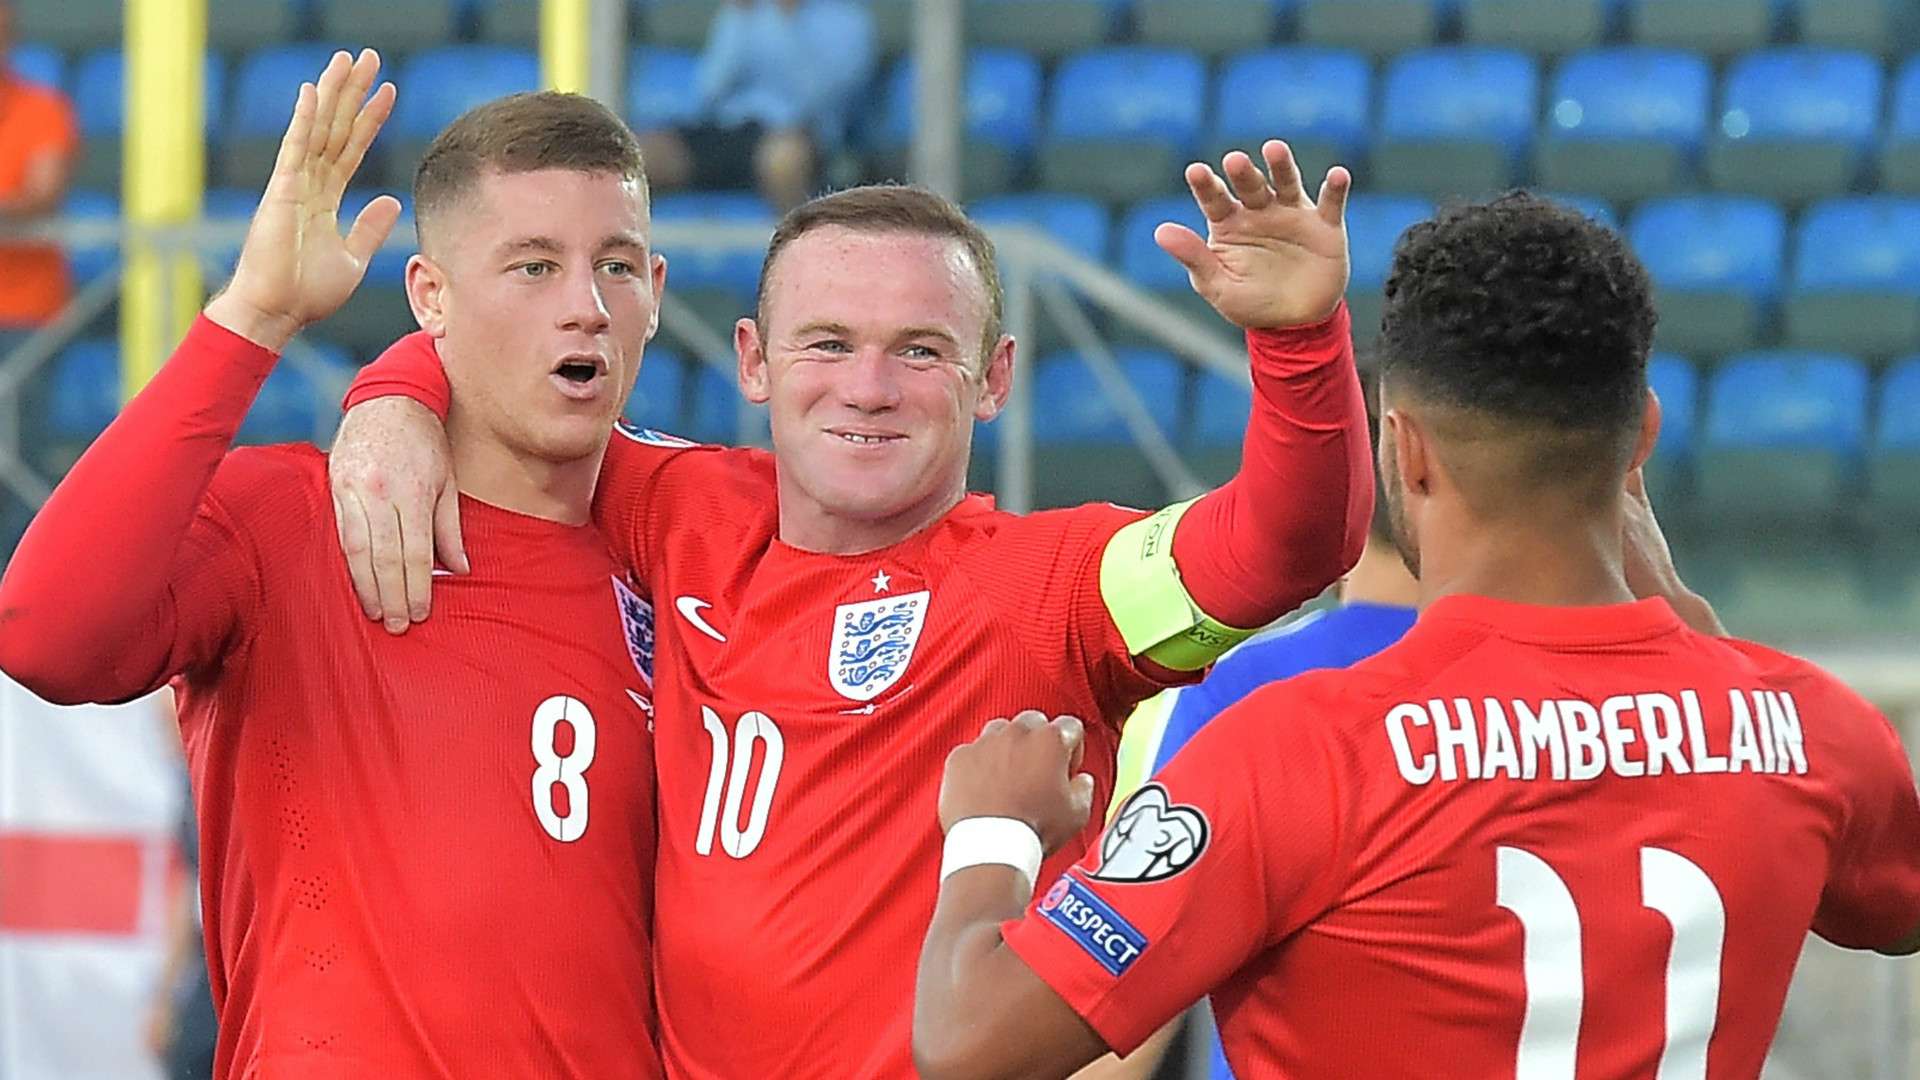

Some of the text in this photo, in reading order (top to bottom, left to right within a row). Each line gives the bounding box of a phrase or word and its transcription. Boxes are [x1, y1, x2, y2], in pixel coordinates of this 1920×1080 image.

[529, 694, 598, 844] 8
[695, 704, 785, 860] 10
[1385, 688, 1809, 785] CHAMBERLAIN
[1058, 894, 1140, 964] RESPECT
[1495, 846, 1726, 1080] 11
